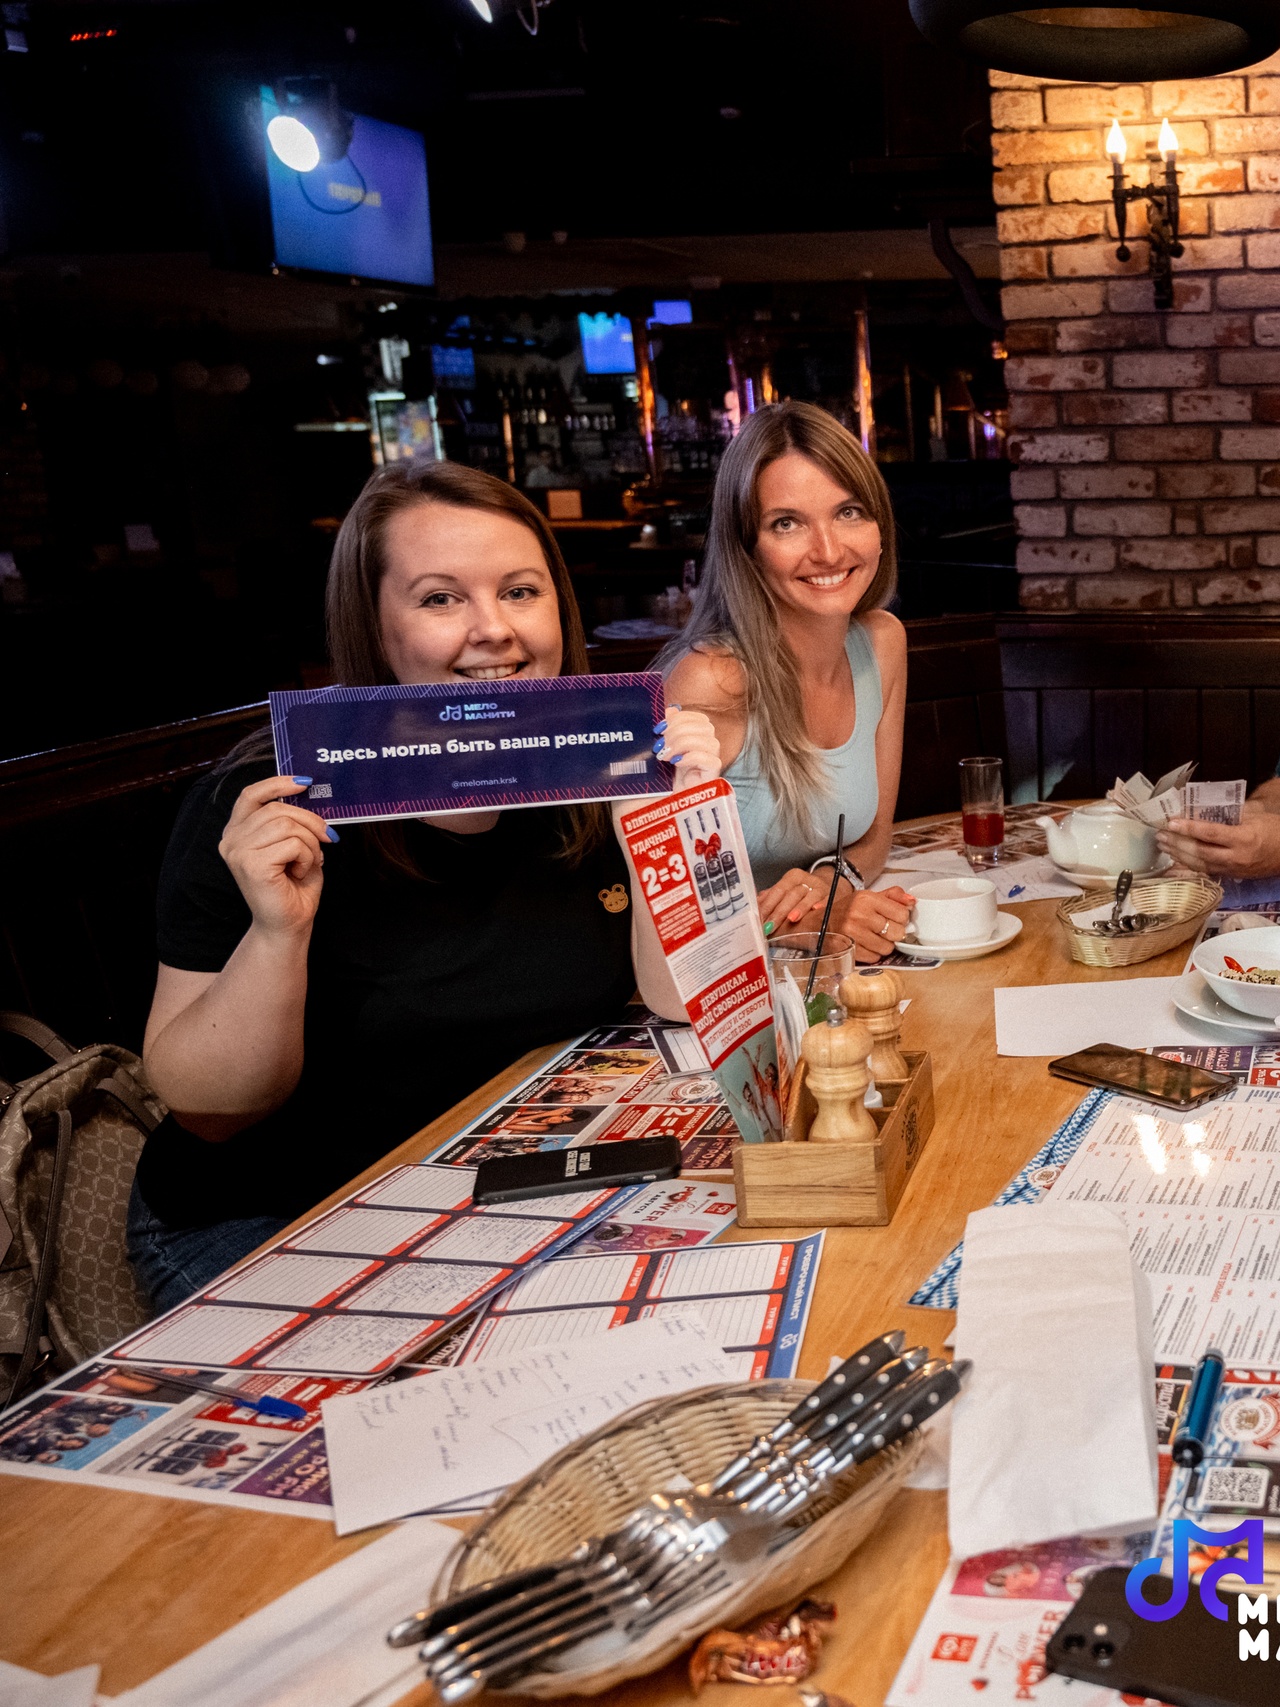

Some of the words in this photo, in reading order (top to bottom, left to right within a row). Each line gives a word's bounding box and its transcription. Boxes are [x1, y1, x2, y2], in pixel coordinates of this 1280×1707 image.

[464, 702, 498, 712] МЕЛО
[464, 711, 516, 721] МАНИТИ
[316, 746, 378, 764] Здесь
[382, 741, 442, 760] могла
[446, 738, 496, 755] быть
[500, 734, 550, 751] ваша
[554, 729, 634, 749] реклама
[451, 776, 519, 790] @meloman.krsk
[625, 821, 633, 832] В
[633, 805, 672, 830] ПЯТНИЦУ
[671, 801, 679, 812] И
[678, 787, 717, 809] СУББОТУ
[631, 824, 678, 855] УДАЧНЫЙ
[648, 845, 668, 860] ЧАС
[641, 853, 688, 897] 2=3
[694, 1011, 715, 1033] ВХОД
[713, 975, 768, 1017] СВОБОДНЫЙ
[700, 971, 748, 1012] ДЕВУШКАМ
[738, 997, 767, 1021] СУББОТУ
